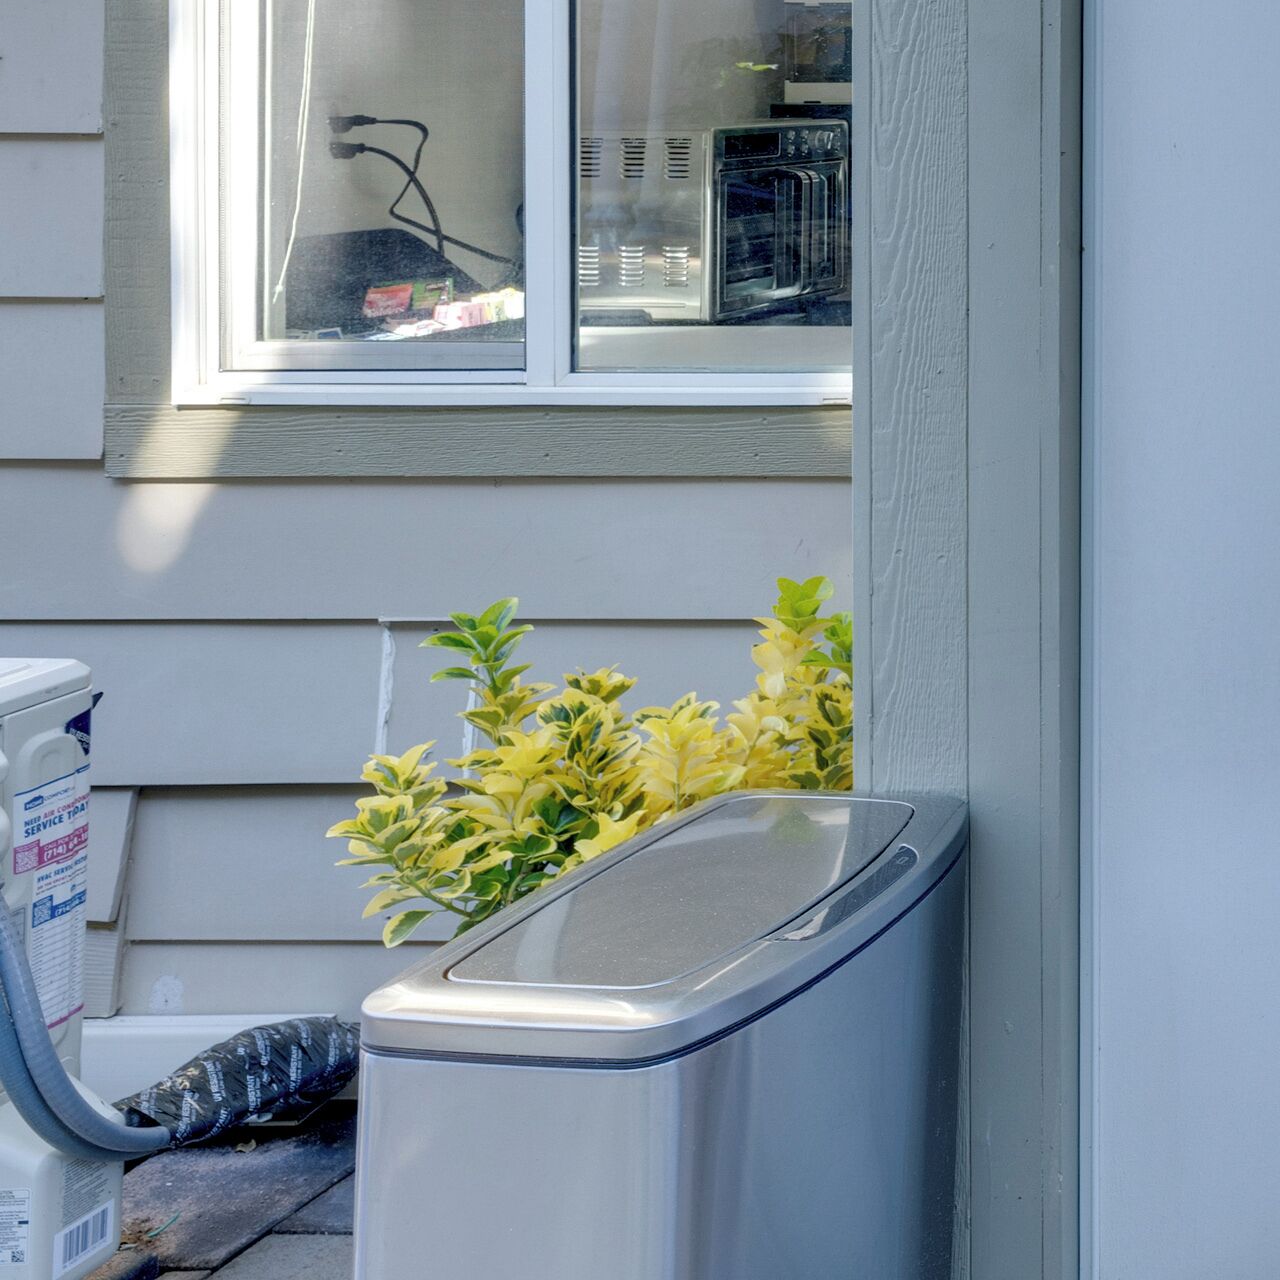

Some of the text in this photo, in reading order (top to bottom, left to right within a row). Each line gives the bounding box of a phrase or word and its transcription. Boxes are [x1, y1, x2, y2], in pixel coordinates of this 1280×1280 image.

[24, 813, 64, 838] SERVICE
[289, 1045, 299, 1081] RESISTANT
[204, 1061, 220, 1093] RESISTANT
[288, 1081, 297, 1093] UV
[211, 1093, 223, 1102] UV
